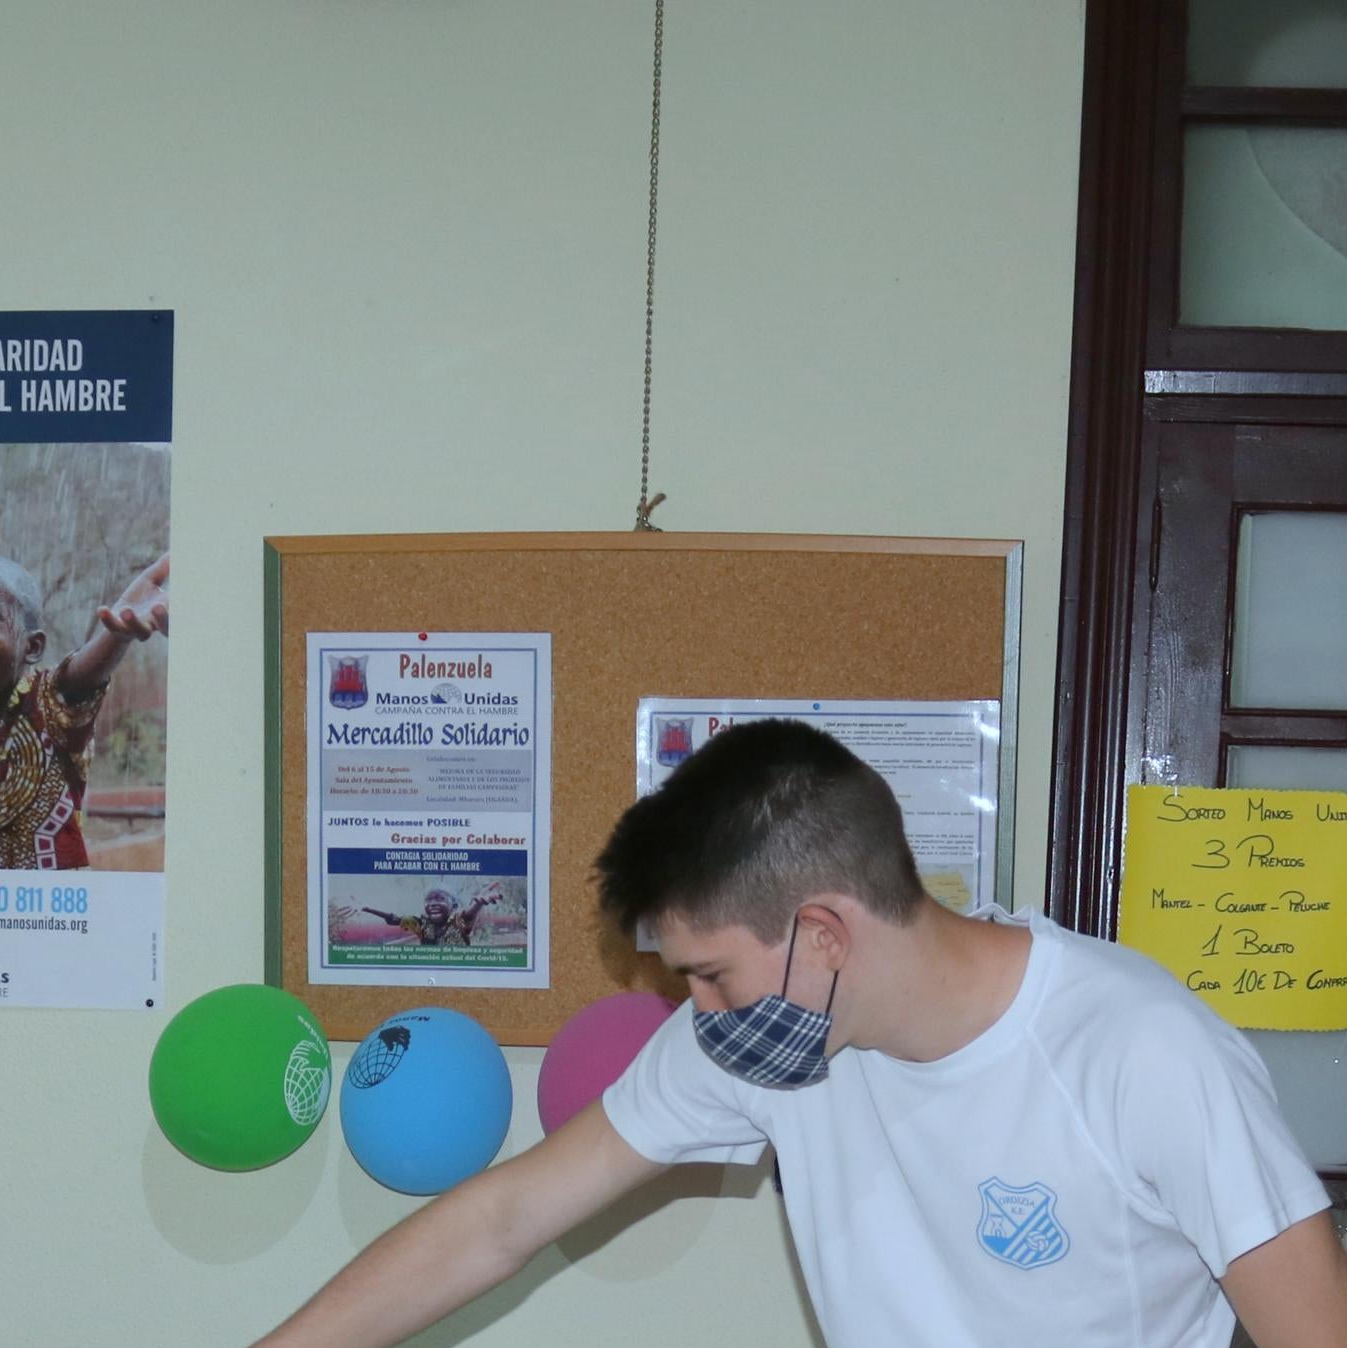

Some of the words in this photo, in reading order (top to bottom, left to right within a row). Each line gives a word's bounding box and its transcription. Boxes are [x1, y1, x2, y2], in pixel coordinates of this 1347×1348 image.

[21, 378, 127, 412] HAMBRE
[399, 653, 493, 679] Palenzuela
[375, 692, 429, 705] Manos
[464, 692, 519, 706] Unidas
[425, 706, 464, 715] CONTRA
[466, 706, 477, 715] EL
[479, 706, 518, 716] HAMBRE
[327, 722, 433, 746] Mercadillo
[441, 722, 529, 746] Solidario
[327, 817, 369, 827] JUNTOS
[372, 818, 381, 826] lo
[385, 818, 423, 827] hacemos
[427, 818, 471, 827] POSIBLE
[391, 833, 437, 845] Gracias
[442, 835, 462, 847] por
[466, 834, 526, 846] Colaborar
[385, 851, 420, 862] CONTAGIA
[422, 851, 469, 862] SOLIDARIDAD
[1192, 839, 1230, 869] 3
[373, 860, 393, 871] PARA
[394, 861, 422, 871] ACABAR
[423, 861, 438, 871] CON
[440, 862, 449, 871] EL
[451, 861, 481, 872] HAMBRE
[16, 886, 44, 913] 811
[51, 887, 89, 914] 888
[1201, 925, 1223, 956] 1
